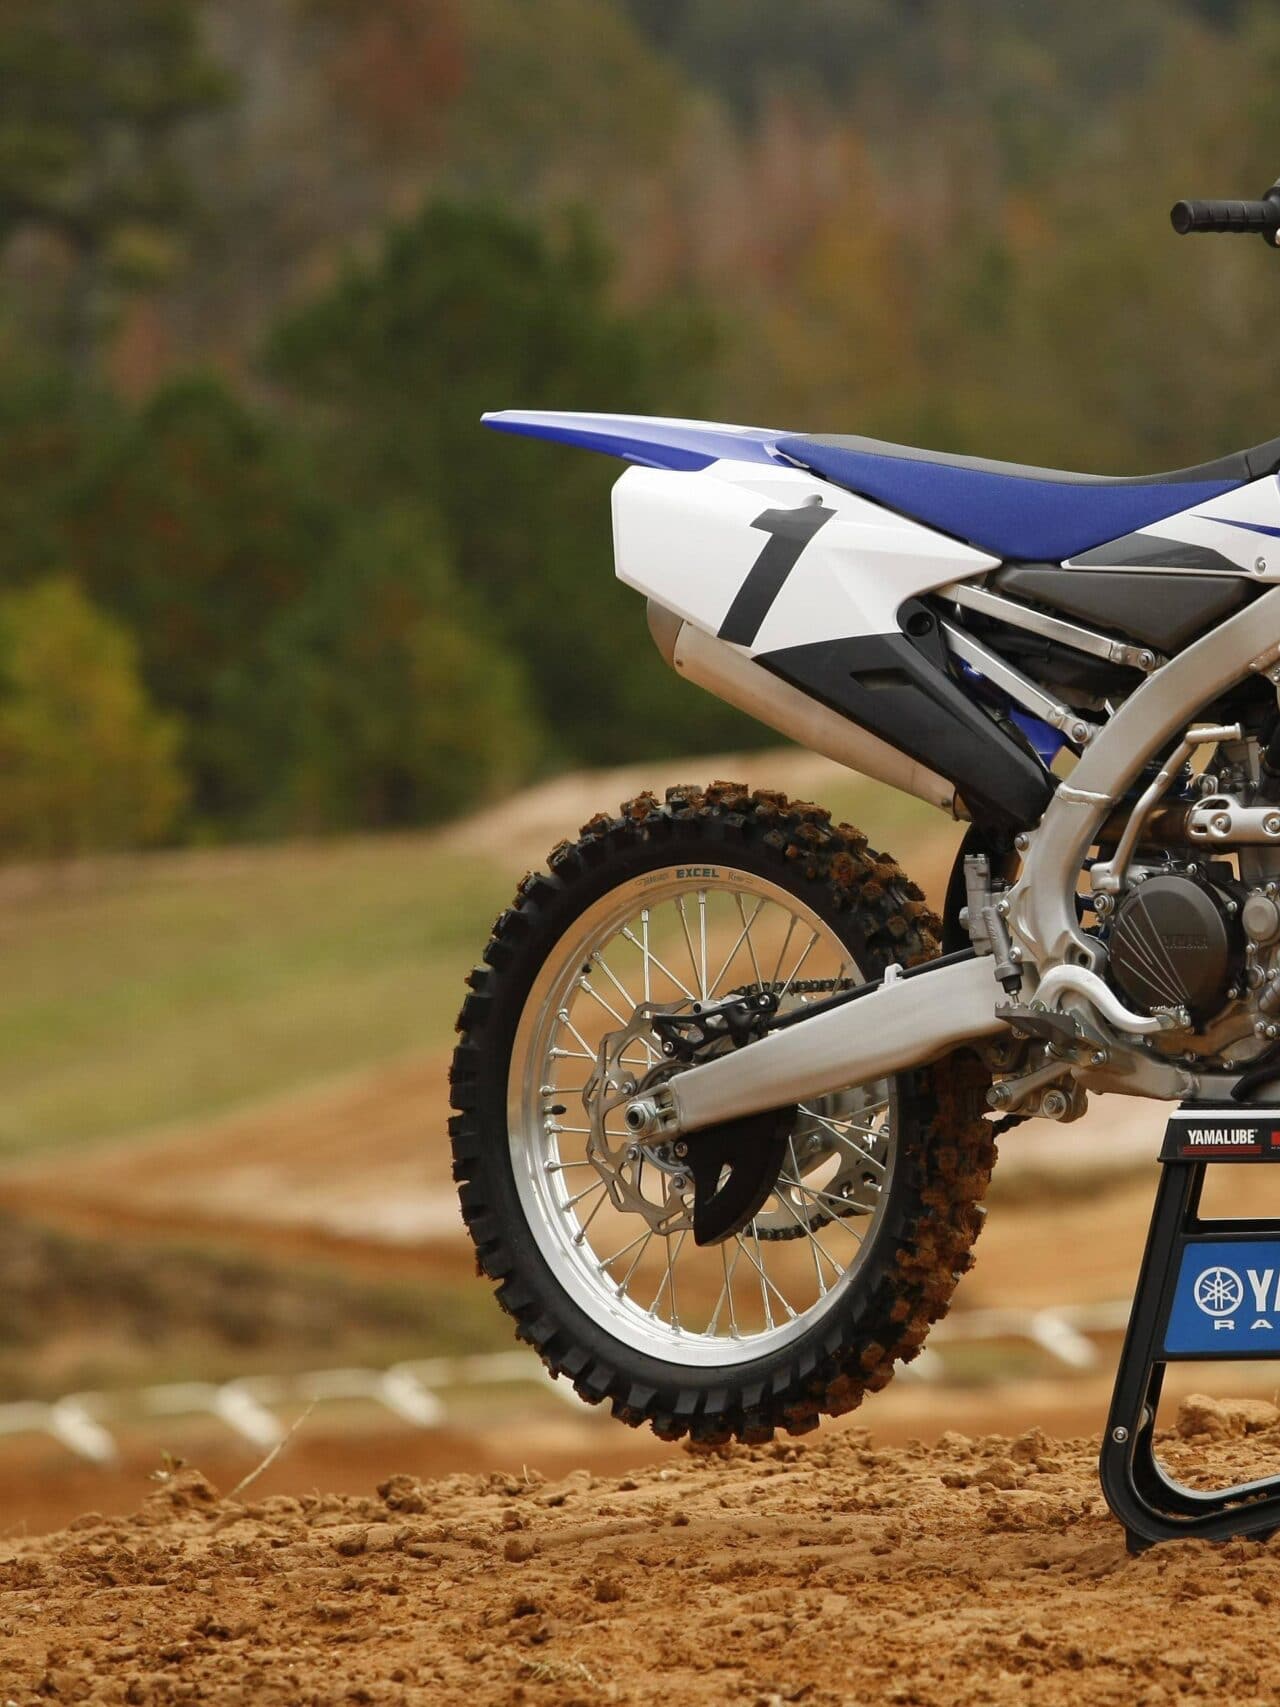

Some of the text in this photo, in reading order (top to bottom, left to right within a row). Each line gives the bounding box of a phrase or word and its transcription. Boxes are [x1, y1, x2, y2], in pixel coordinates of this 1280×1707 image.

[717, 507, 838, 648] 1
[676, 868, 720, 879] EXCEL
[1187, 1128, 1256, 1145] YAMALUBE
